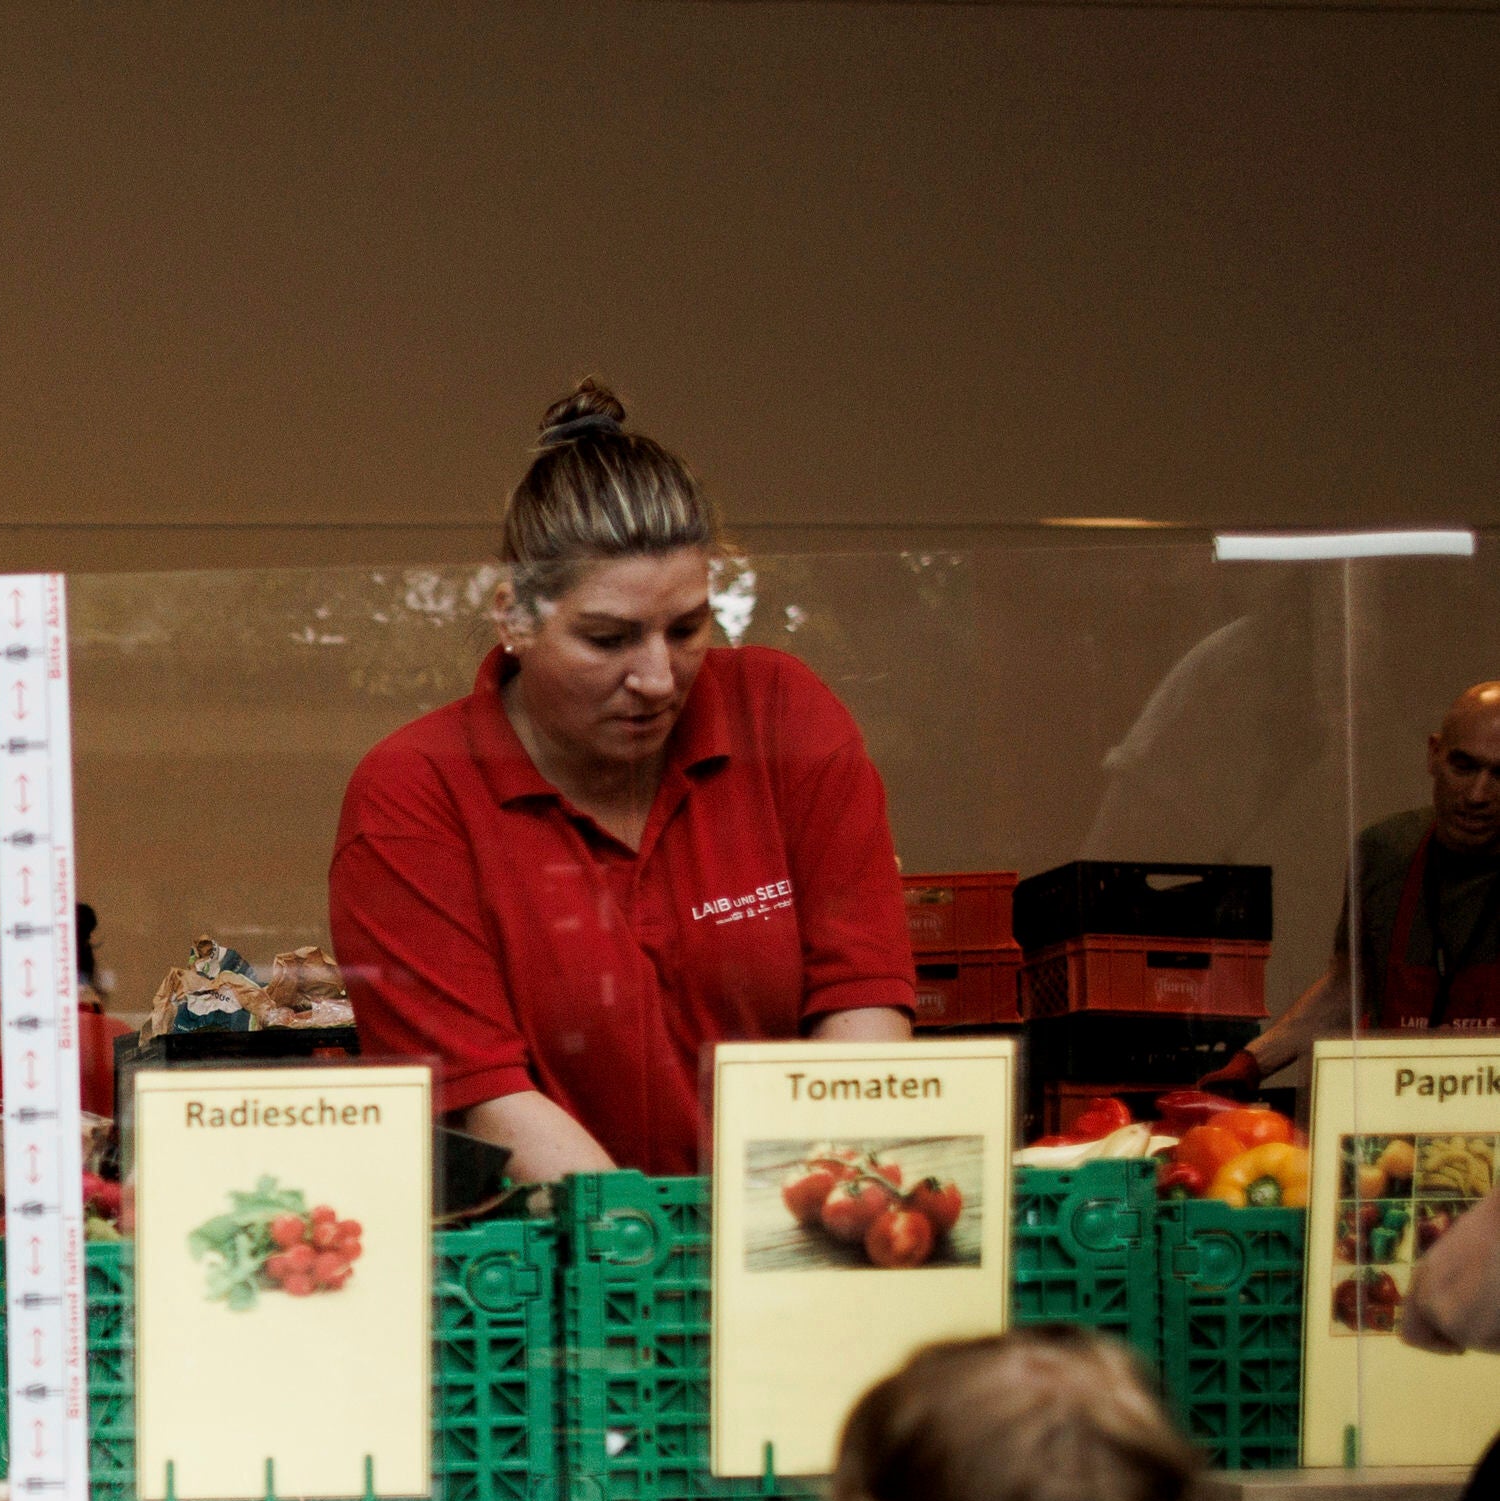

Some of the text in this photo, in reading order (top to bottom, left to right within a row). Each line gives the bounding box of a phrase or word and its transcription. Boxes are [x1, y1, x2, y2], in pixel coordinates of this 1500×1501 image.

[54, 857, 69, 916] halten
[691, 897, 732, 920] LAIB
[56, 922, 70, 996] Abstand
[58, 1005, 72, 1050] Bitte
[785, 1073, 942, 1101] Tomaten
[185, 1097, 382, 1128] Radieschen
[64, 1228, 78, 1286] halten
[66, 1292, 80, 1368] Abstand
[66, 1375, 80, 1419] Bitte
